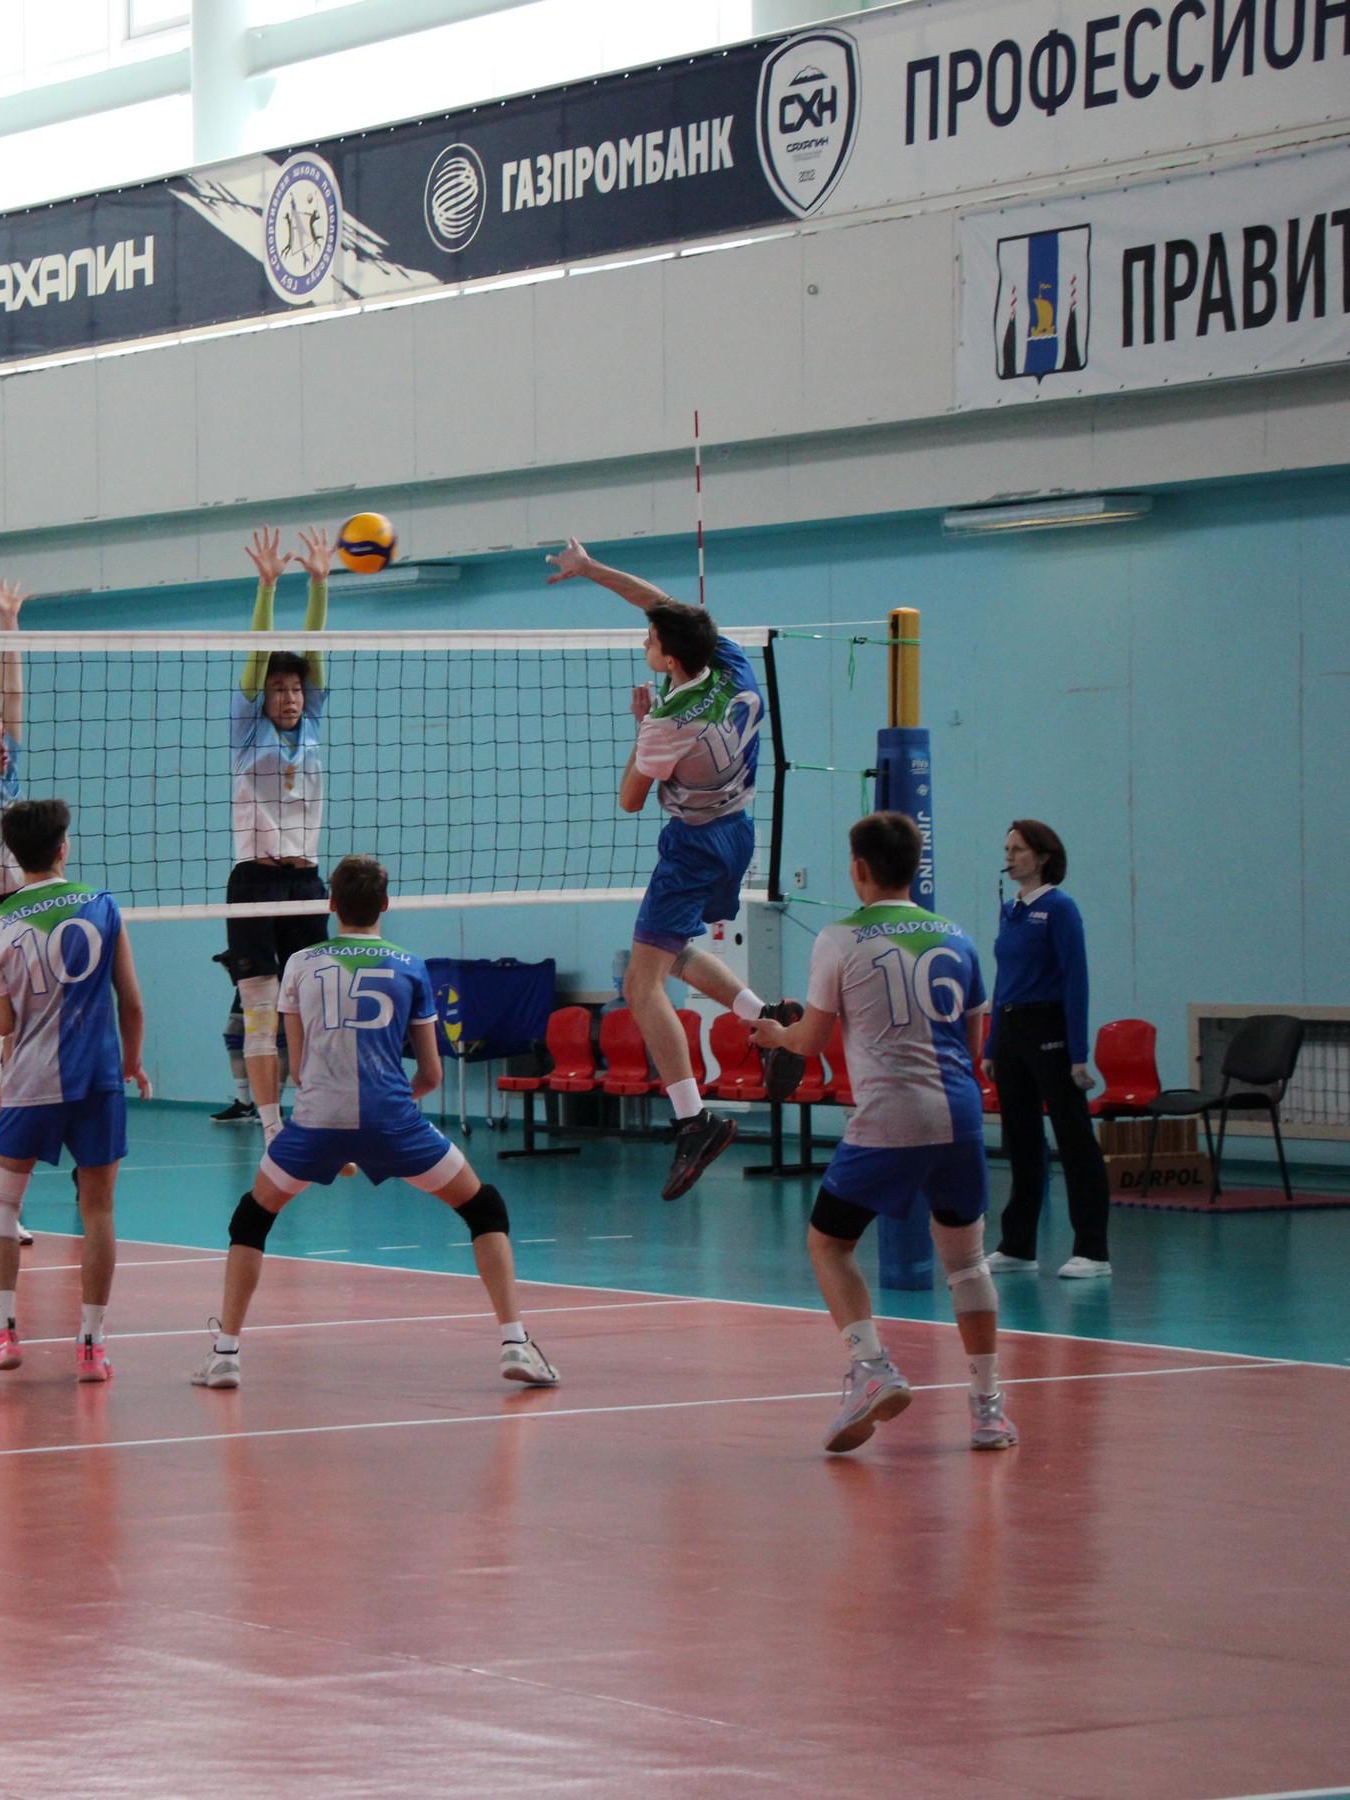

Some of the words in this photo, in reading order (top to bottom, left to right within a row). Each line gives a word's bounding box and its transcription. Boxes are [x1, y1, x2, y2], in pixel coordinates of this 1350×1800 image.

[779, 85, 837, 134] СХН
[905, 0, 1350, 145] ПРОФЕССИОН
[502, 114, 734, 213] ГАЗПРОМБАНК
[696, 690, 763, 774] 12
[11, 918, 103, 995] 10
[305, 946, 411, 965] ХАБАРОВСК
[872, 947, 964, 1027] 16
[314, 965, 395, 1030] 15
